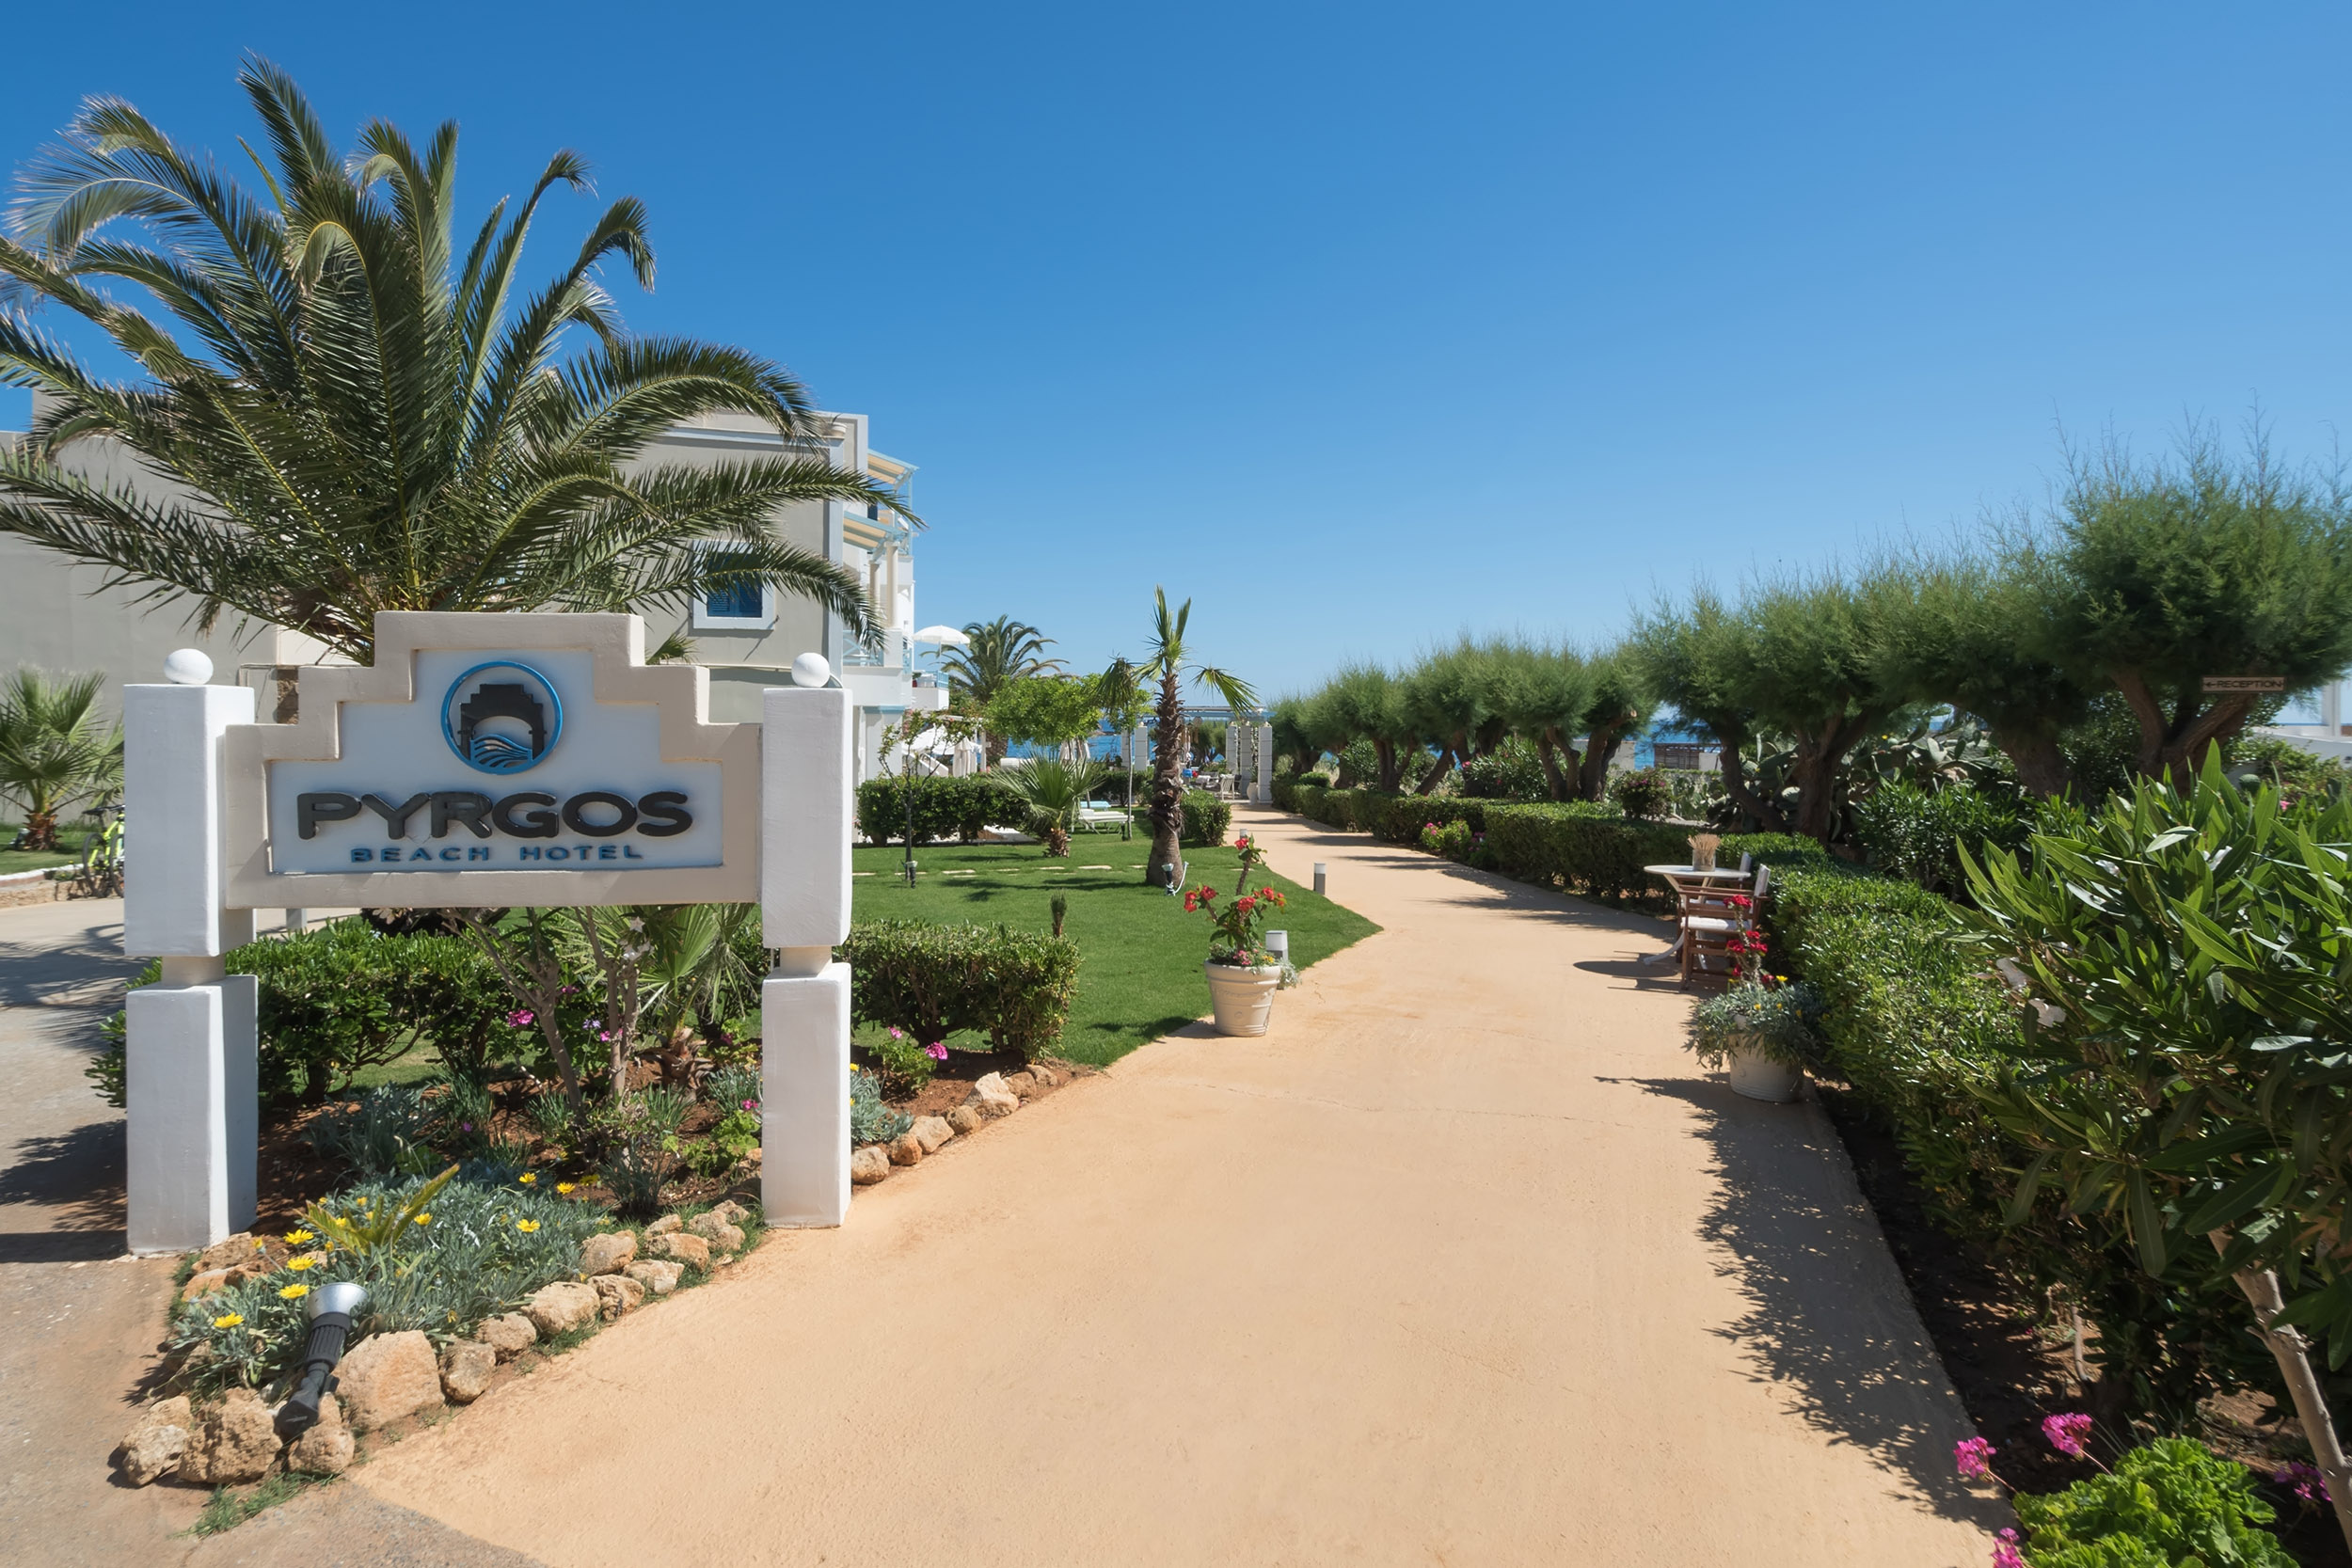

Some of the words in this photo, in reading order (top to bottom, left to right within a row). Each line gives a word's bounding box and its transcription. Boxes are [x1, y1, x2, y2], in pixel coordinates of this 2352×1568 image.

[296, 791, 693, 840] PYRGOS
[350, 847, 490, 863] BEACH
[519, 845, 644, 860] HOTEL
